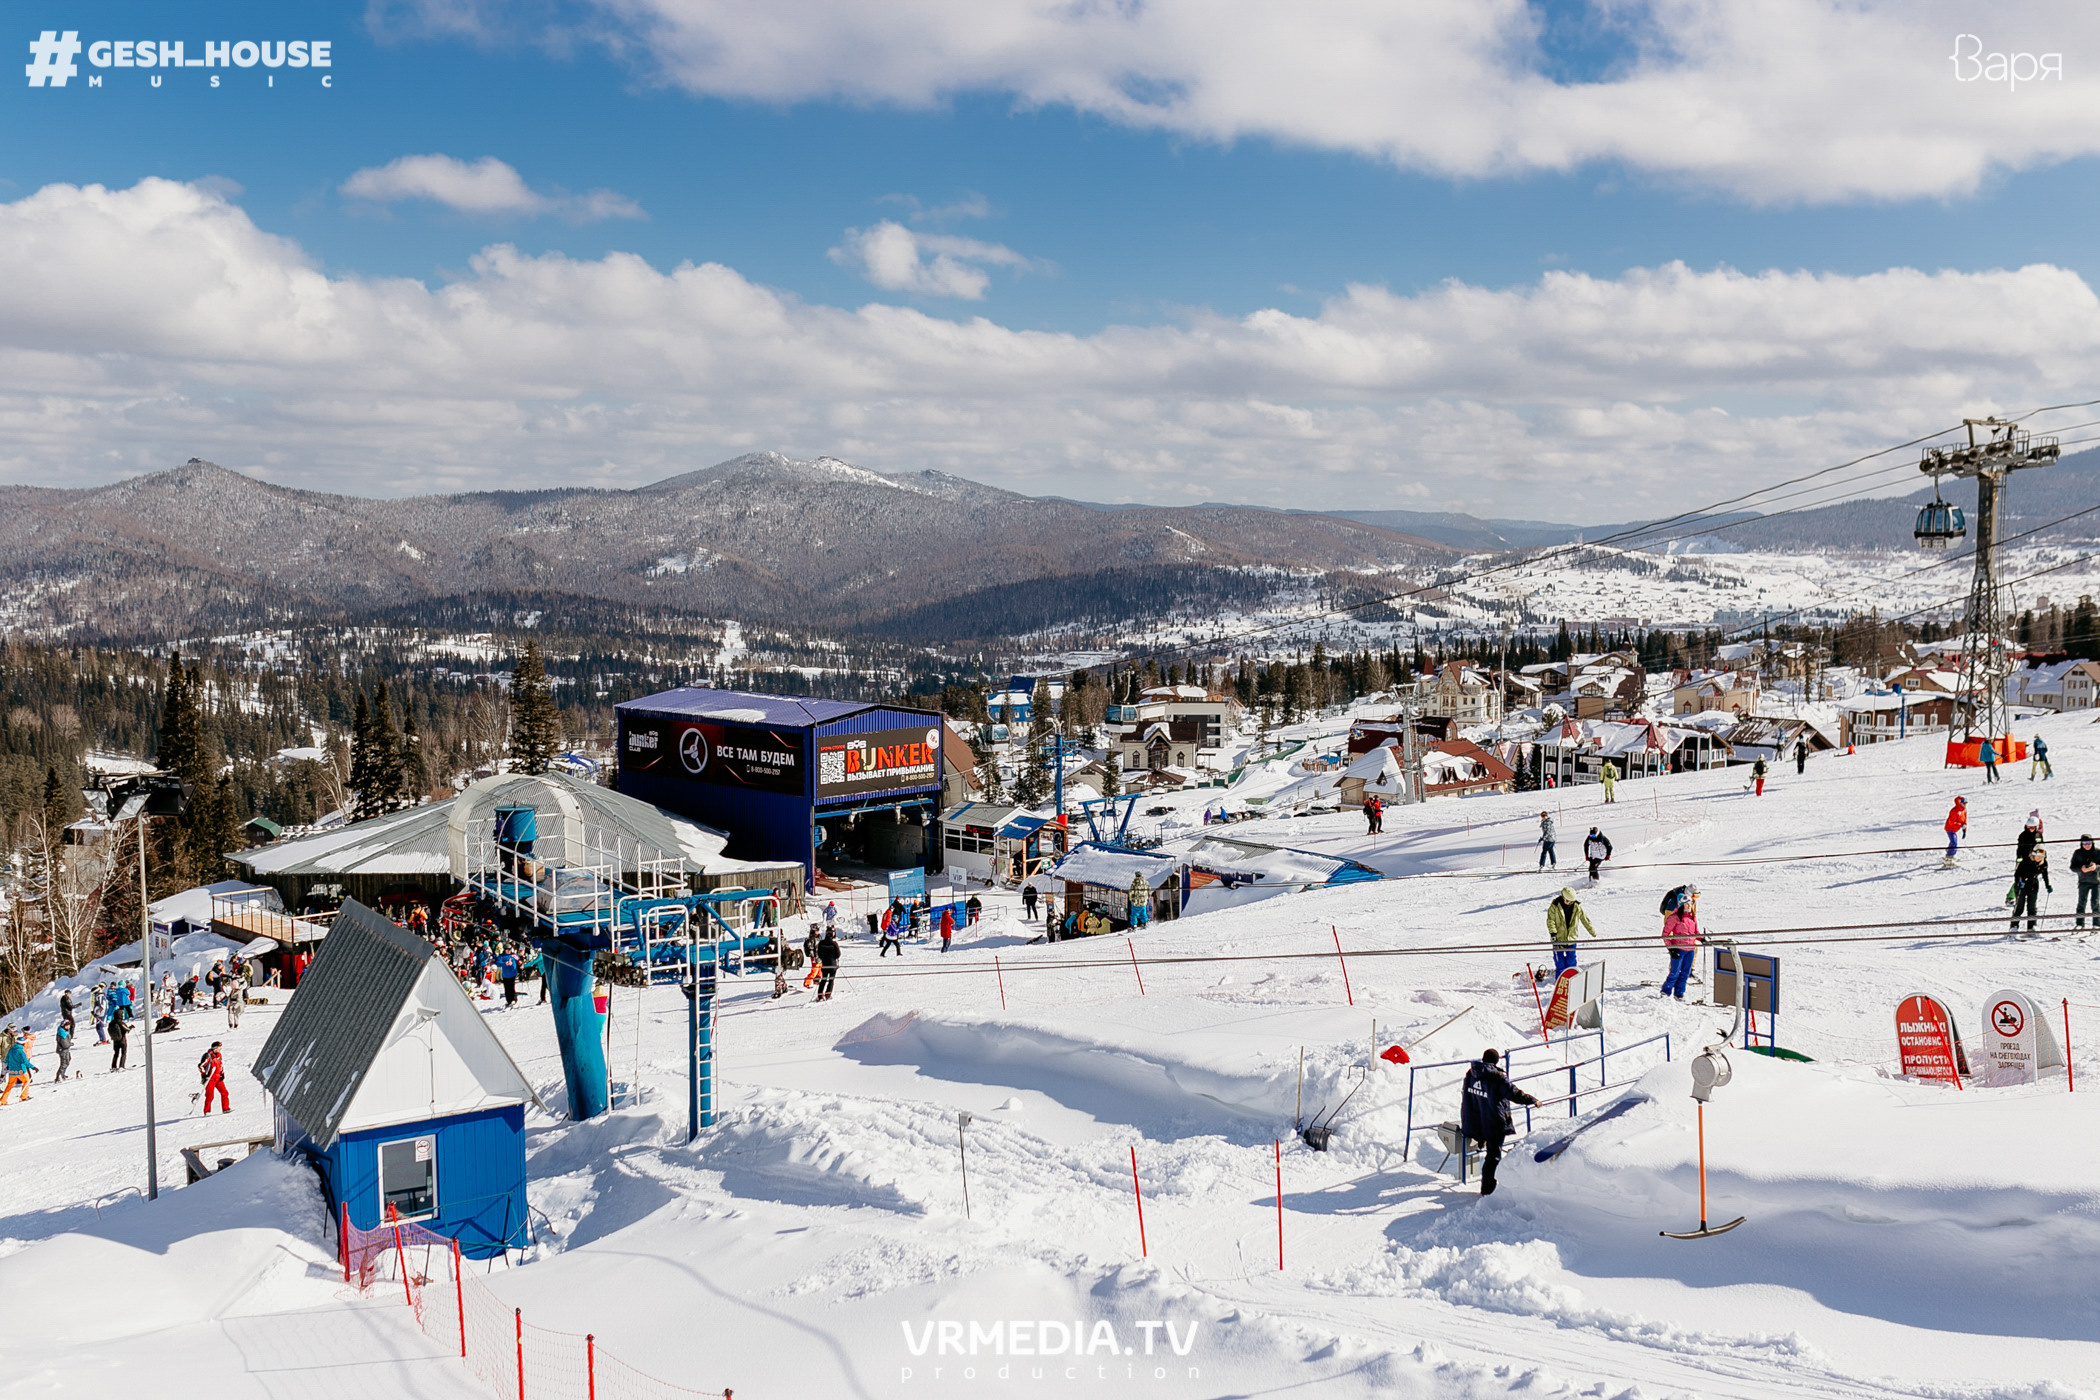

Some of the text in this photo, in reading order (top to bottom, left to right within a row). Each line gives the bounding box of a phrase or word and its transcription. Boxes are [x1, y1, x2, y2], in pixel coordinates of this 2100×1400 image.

[716, 745, 795, 767] ВСЕ ТАМ БУДЕМ
[846, 742, 935, 773] BUNKER
[846, 763, 935, 782] ВЫЗЫВАЕТ ПРИВЫКАНИЕ
[952, 873, 963, 882] VIP
[1901, 1036, 1949, 1046] ОСТАНОВИС!
[2000, 1042, 2020, 1051] ПРОЕЗД
[1904, 1055, 1951, 1065] ПРОПУСТИ
[1990, 1051, 2032, 1061] НА СНЕГОХОДАХ
